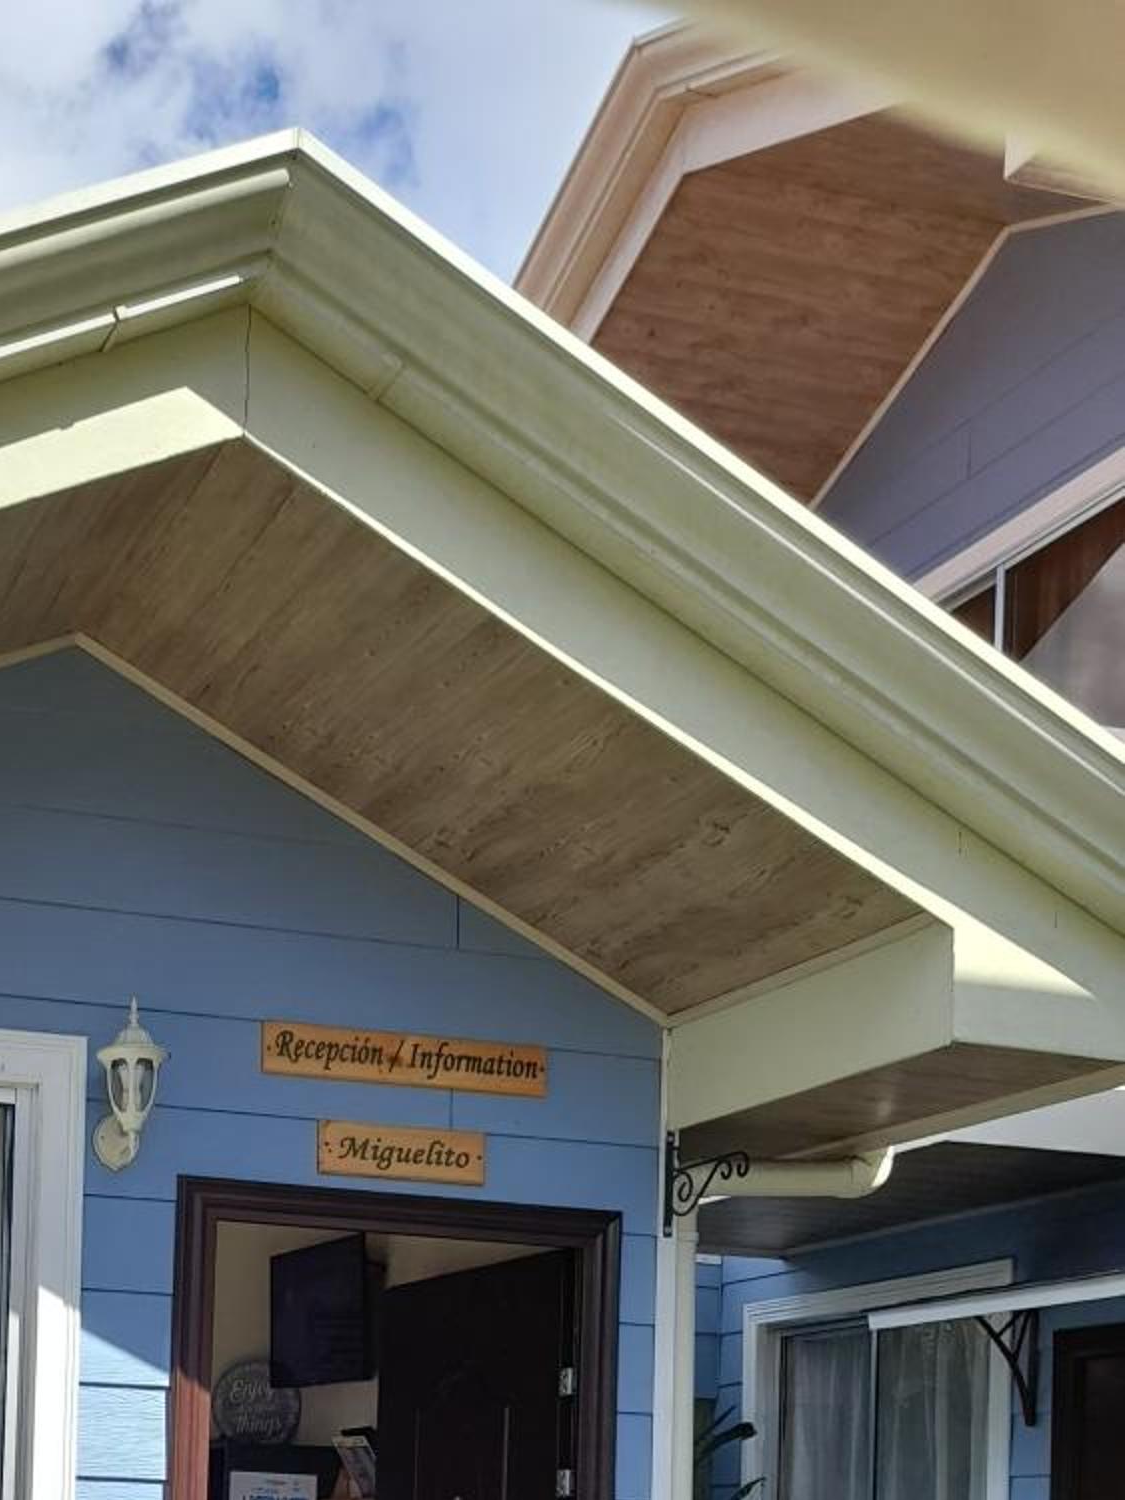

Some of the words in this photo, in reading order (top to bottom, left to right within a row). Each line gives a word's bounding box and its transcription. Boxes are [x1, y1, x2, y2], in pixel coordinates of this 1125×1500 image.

[275, 1030, 384, 1070] Recepción
[410, 1042, 539, 1079] Information
[339, 1136, 470, 1170] Miguelito
